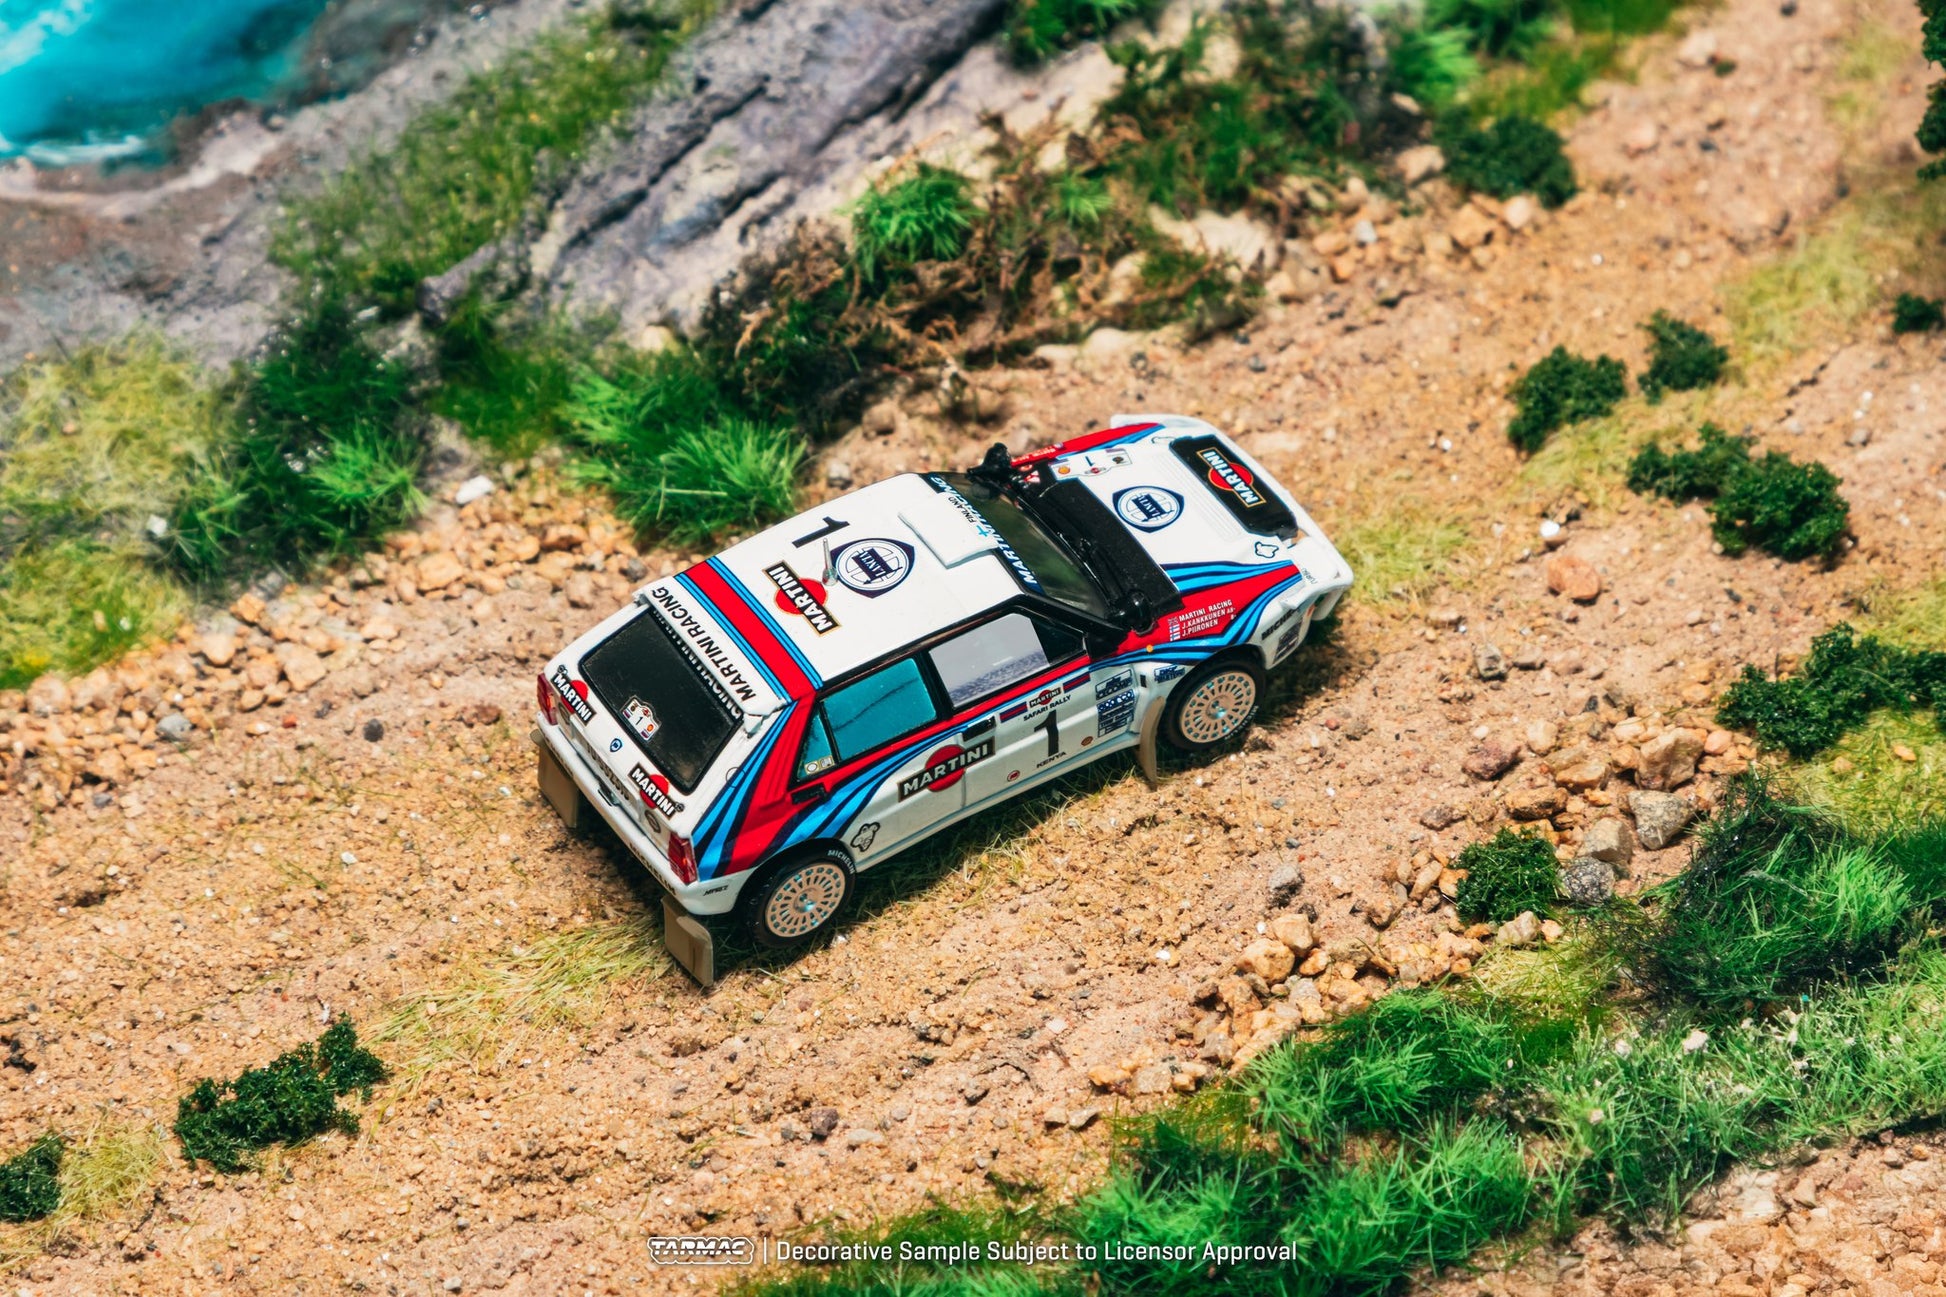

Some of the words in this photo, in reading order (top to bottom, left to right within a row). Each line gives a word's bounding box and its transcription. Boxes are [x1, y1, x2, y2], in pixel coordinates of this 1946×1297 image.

[1202, 450, 1260, 504] MARTINI
[791, 516, 850, 549] 1
[947, 496, 977, 524] FINLAND
[651, 586, 706, 639] RACING
[767, 566, 833, 632] MARTINI
[1178, 607, 1206, 622] MARTINI
[1207, 599, 1233, 612] RACING
[696, 636, 757, 702] MARTINI
[553, 673, 592, 721] MARTINI
[1023, 705, 1048, 721] SAFARI
[1049, 694, 1071, 709] RALLY
[1030, 688, 1060, 707] MARTINI
[1034, 709, 1060, 757] 1
[903, 743, 989, 796] MARTINI
[1036, 751, 1067, 769] KENYA
[631, 767, 676, 816] MARTINI
[827, 850, 855, 875] MICHELIN
